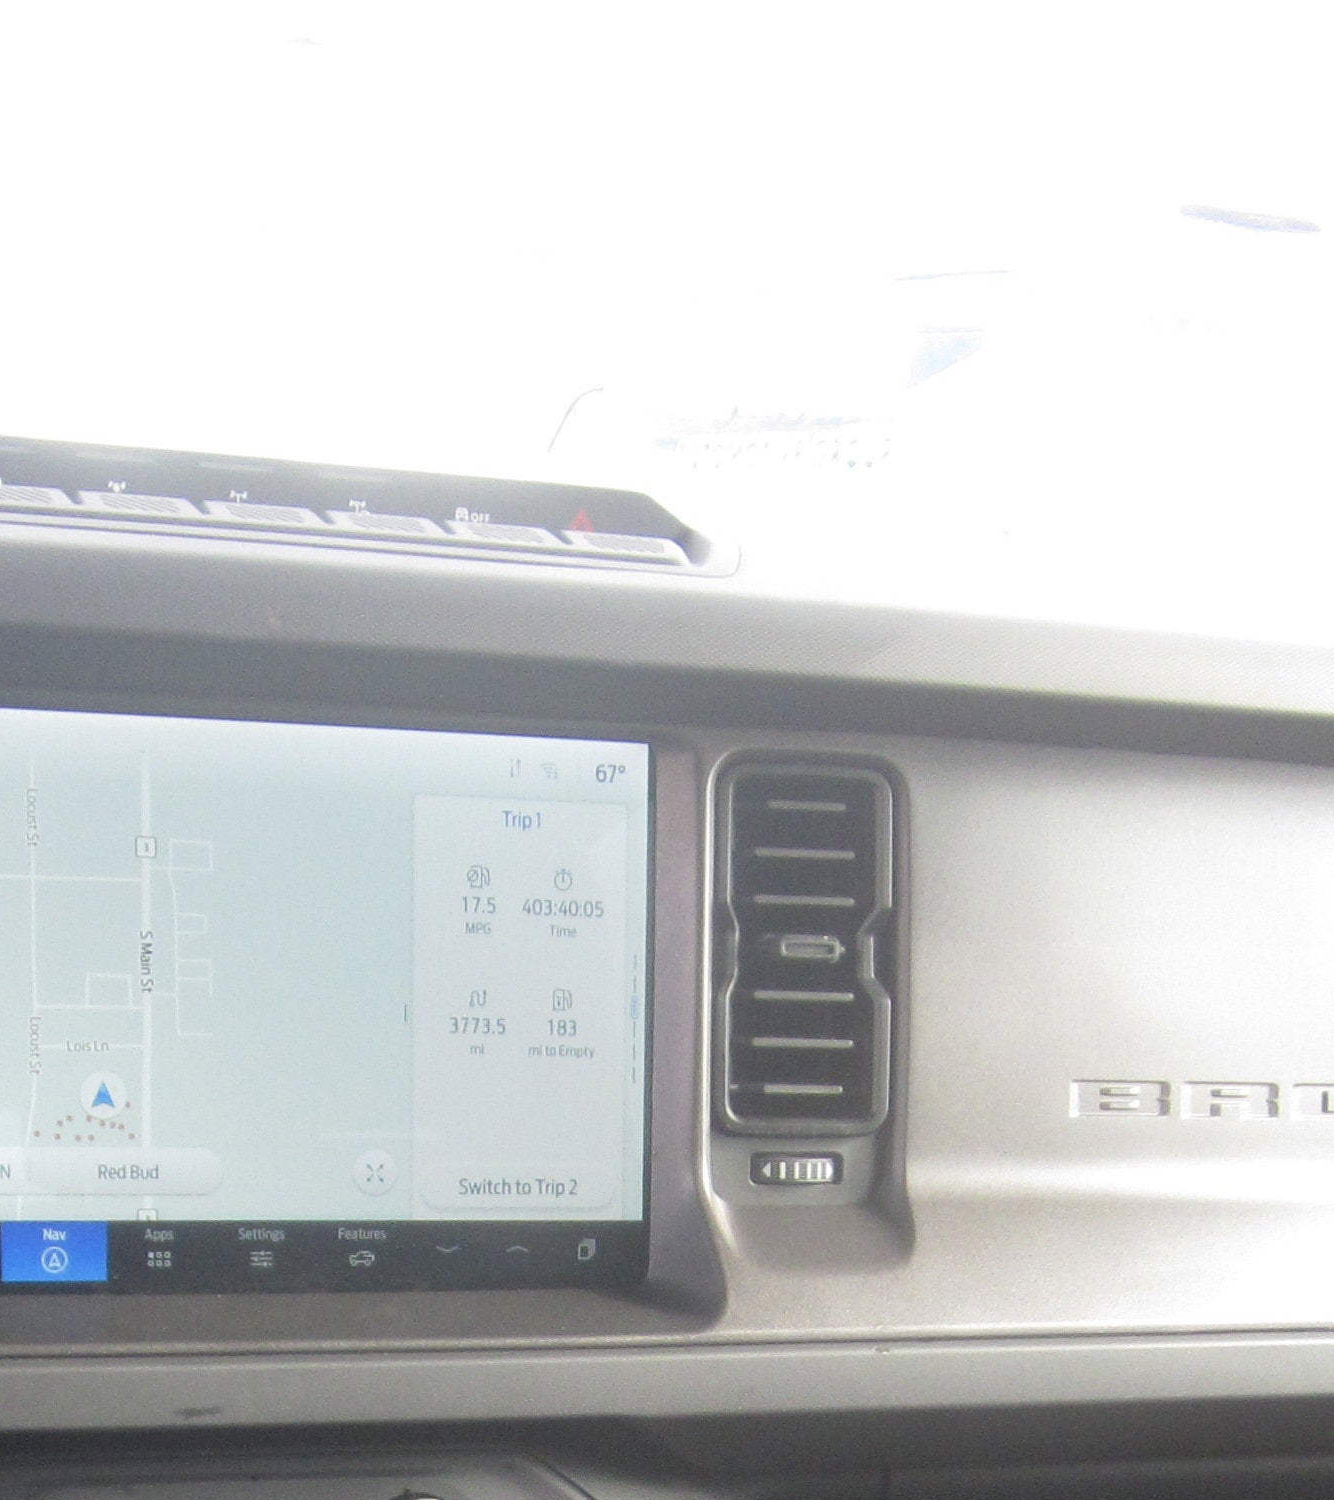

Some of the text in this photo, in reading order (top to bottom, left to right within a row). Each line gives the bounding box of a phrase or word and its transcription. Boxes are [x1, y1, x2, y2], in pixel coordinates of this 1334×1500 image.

[471, 512, 490, 523] OFF
[595, 764, 626, 783] 67°
[26, 788, 39, 847] Locust St
[502, 810, 542, 830] Trip 1
[462, 896, 496, 914] 17.5
[522, 898, 604, 917] 403:40:05
[465, 922, 491, 934] MPG
[550, 925, 576, 937] Time
[140, 931, 154, 993] S Main St
[449, 1017, 506, 1035] 3773.5
[547, 1019, 577, 1036] 183
[29, 1016, 42, 1074] Locust St
[67, 1040, 109, 1051] Lois Ln
[470, 1044, 484, 1055] mi
[528, 1045, 595, 1059] mi to Empty
[0, 1164, 11, 1179] N
[98, 1165, 159, 1180] Red Bud
[458, 1178, 578, 1197] Switch to Trip 2
[42, 1228, 67, 1241] Nav
[144, 1228, 174, 1242] Apps
[238, 1228, 285, 1242] Settings
[337, 1228, 387, 1240] Features
